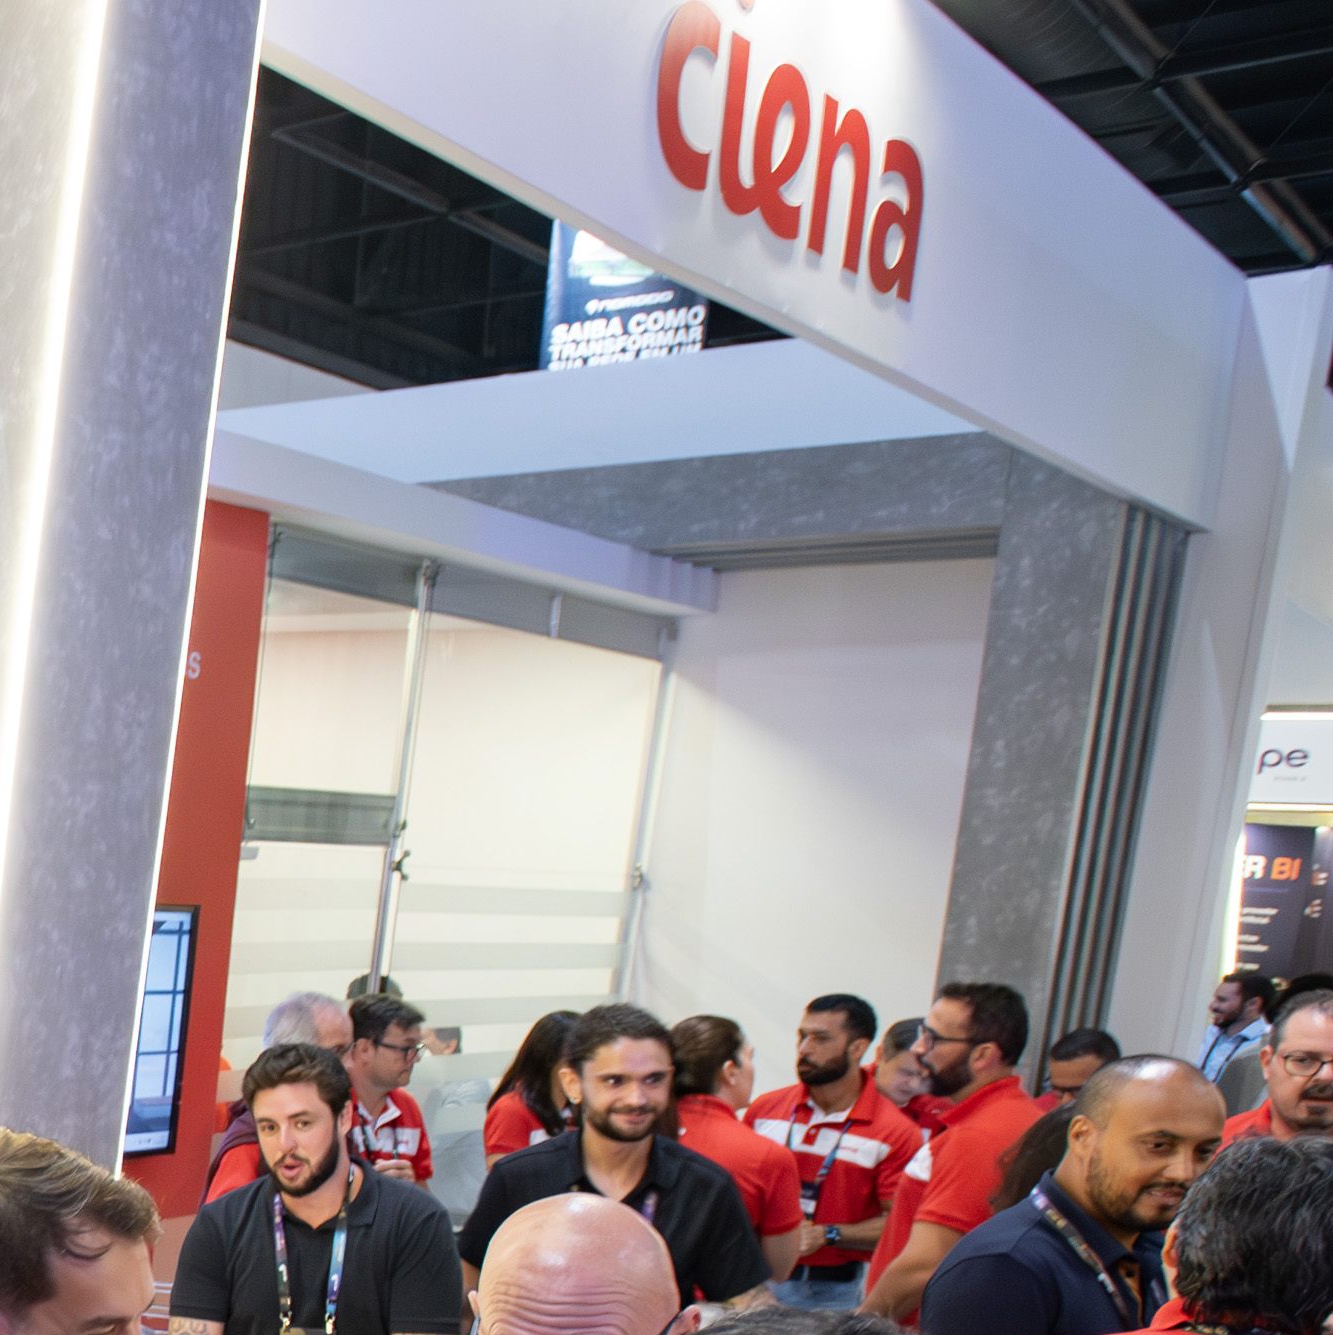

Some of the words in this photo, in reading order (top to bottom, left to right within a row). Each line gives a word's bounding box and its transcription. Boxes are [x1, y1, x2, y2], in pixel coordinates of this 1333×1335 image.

[657, 0, 924, 303] ciena
[548, 325, 704, 361] TRANSFORMAR
[550, 316, 624, 344] SAIBA
[627, 304, 707, 336] COMO
[1270, 856, 1302, 881] BI
